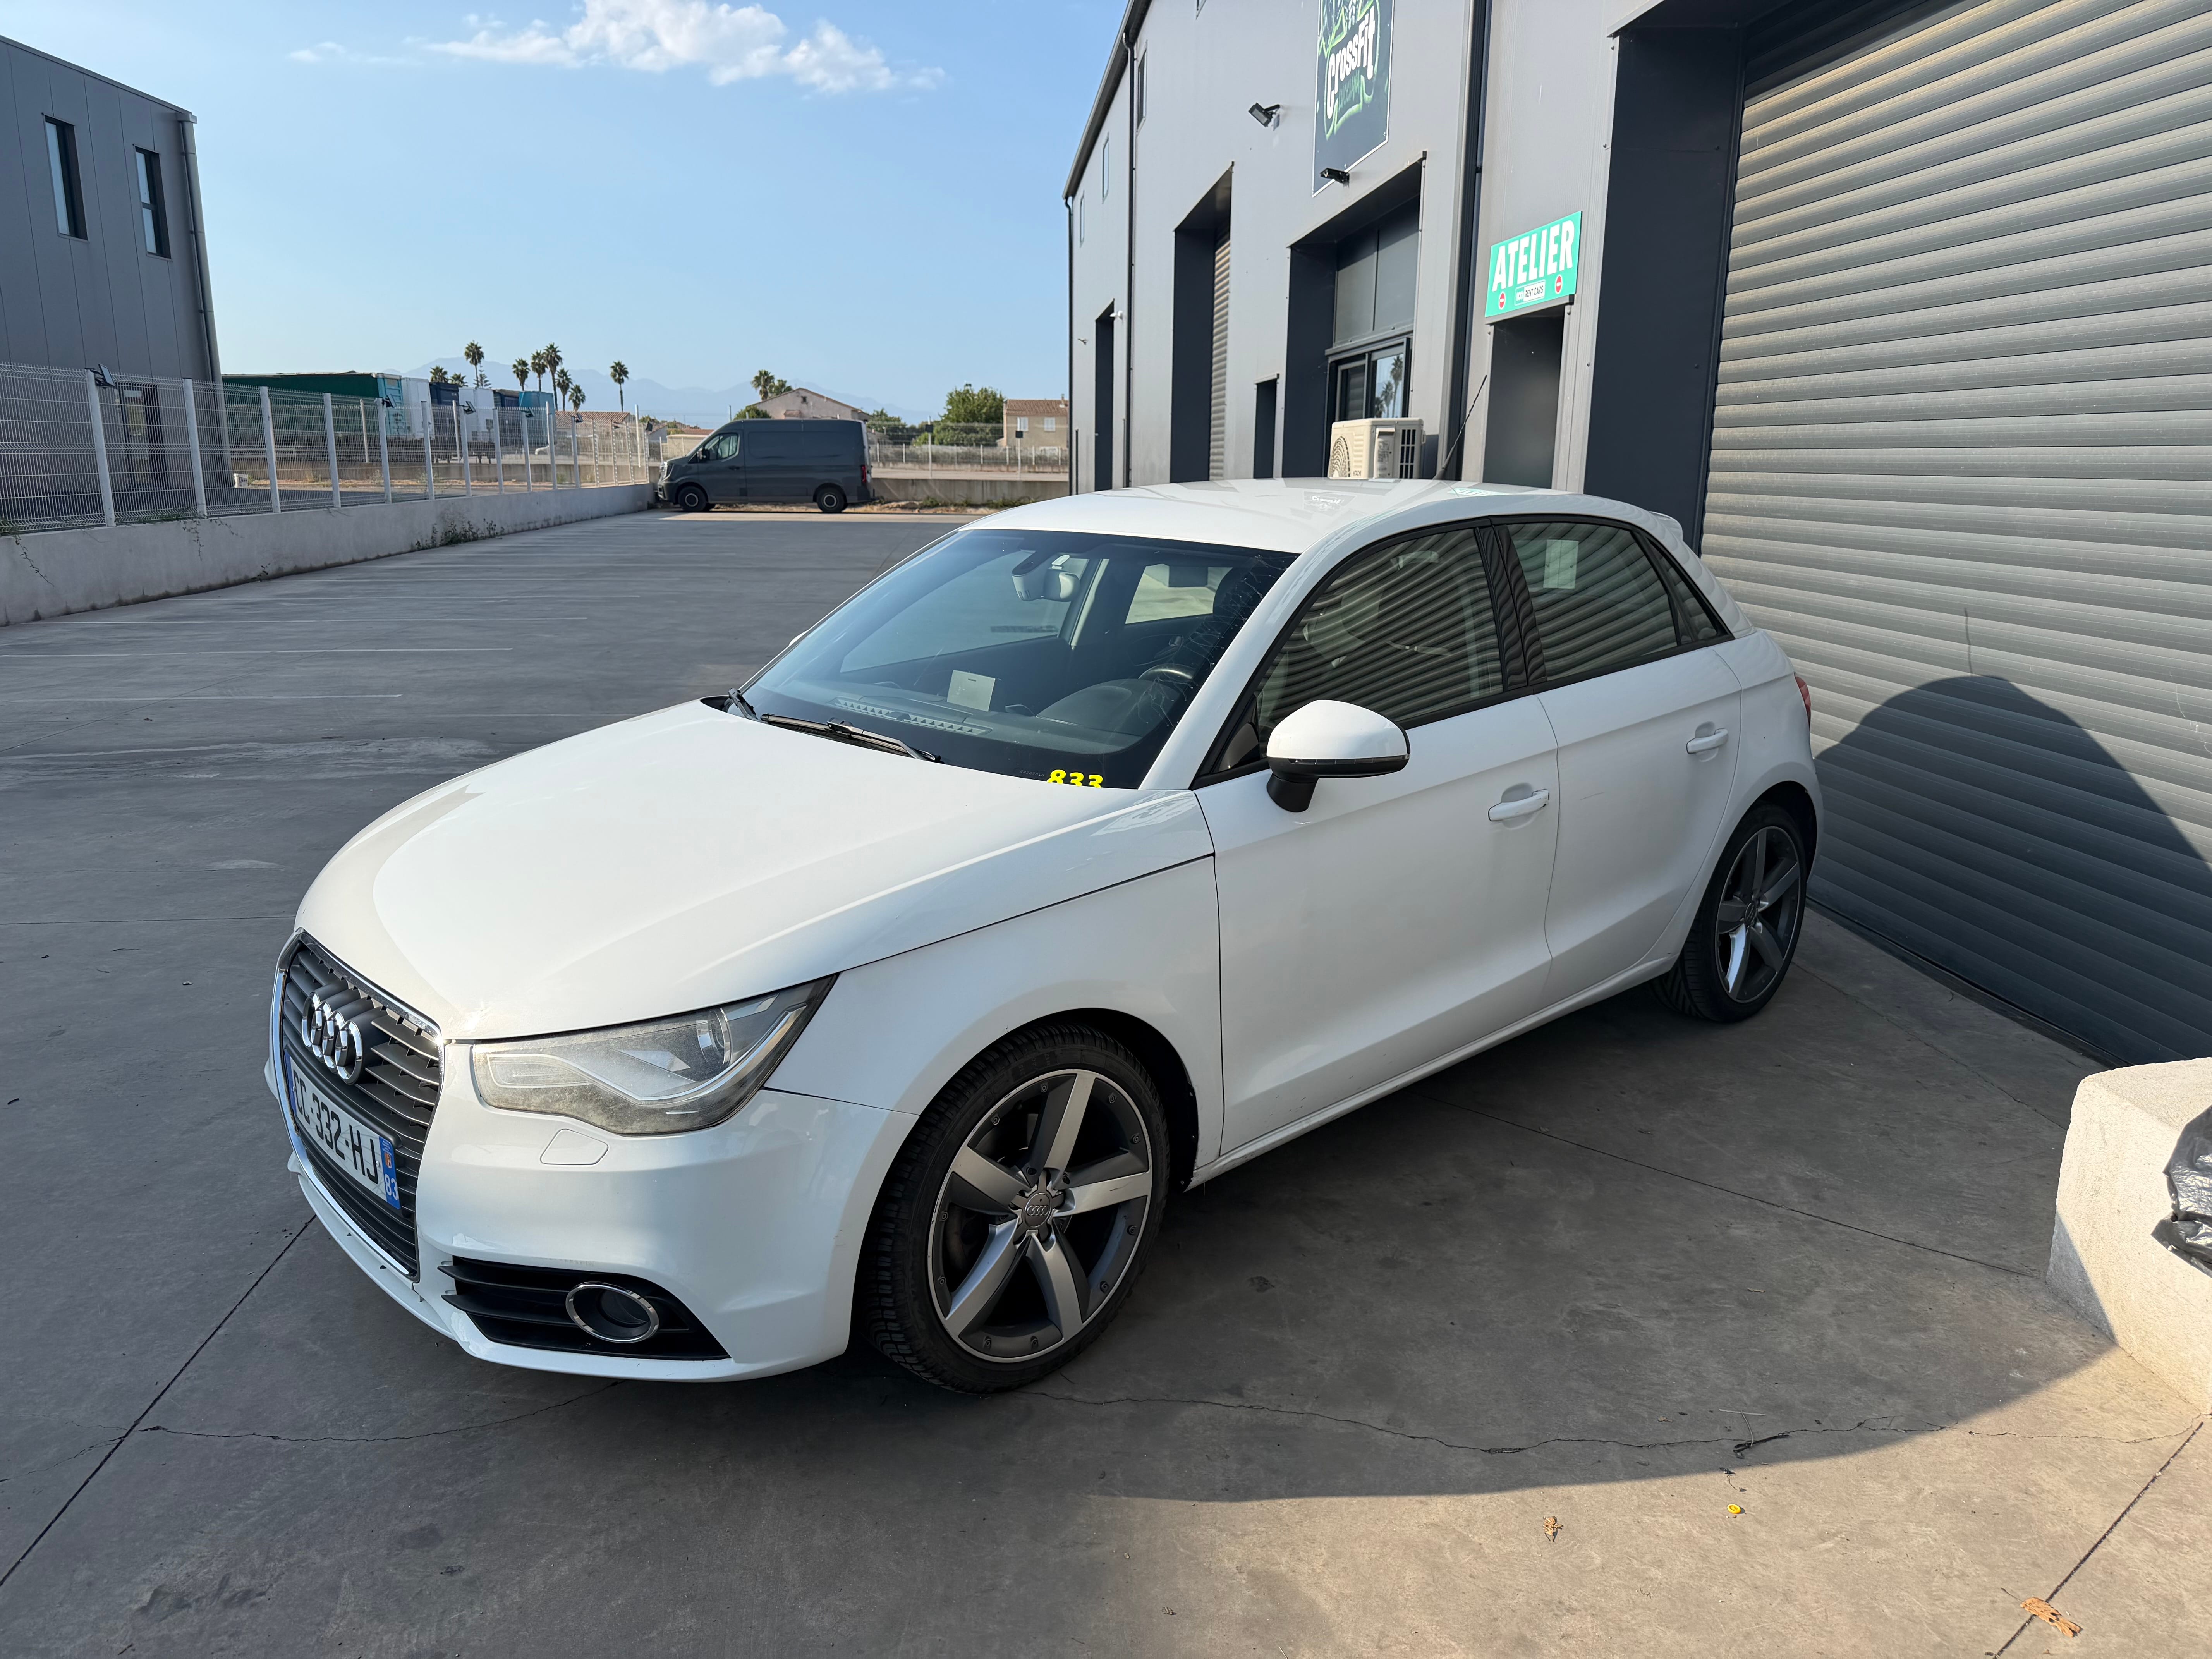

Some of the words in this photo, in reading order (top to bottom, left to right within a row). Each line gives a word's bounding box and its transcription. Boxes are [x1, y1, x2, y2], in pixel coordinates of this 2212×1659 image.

[1326, 5, 1376, 119] CrossFit
[1491, 220, 1575, 292] ATELIER
[1047, 769, 1103, 788] 833
[385, 1174, 398, 1200] 83
